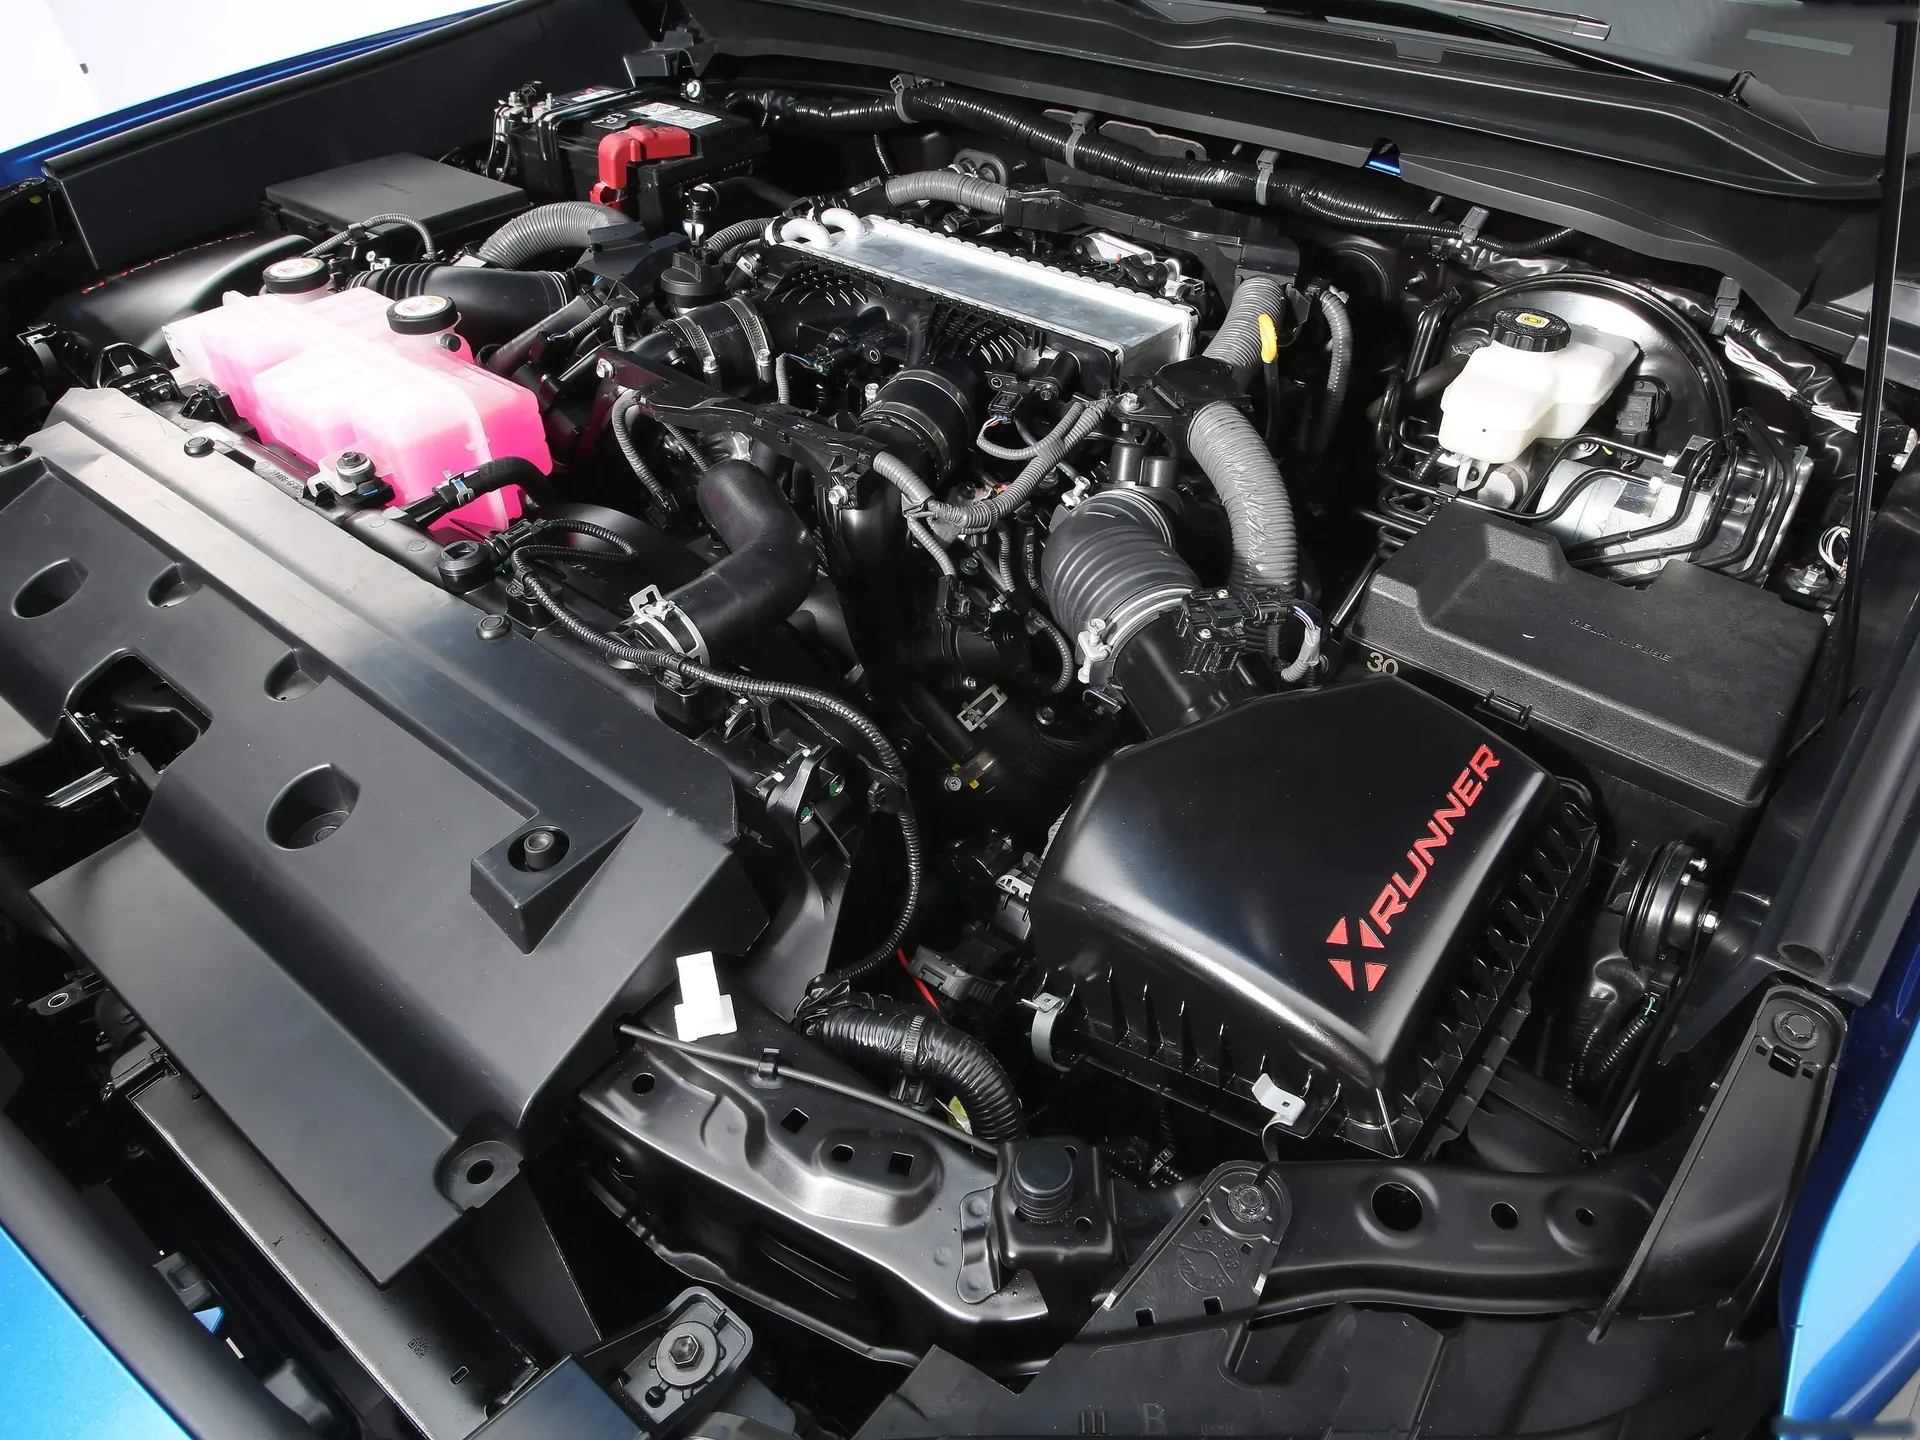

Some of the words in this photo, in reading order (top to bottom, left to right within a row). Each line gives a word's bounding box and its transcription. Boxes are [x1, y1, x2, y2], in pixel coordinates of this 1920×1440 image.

[1570, 618, 1616, 640] RELAY
[1631, 642, 1672, 663] FUSE
[1366, 651, 1399, 676] 30
